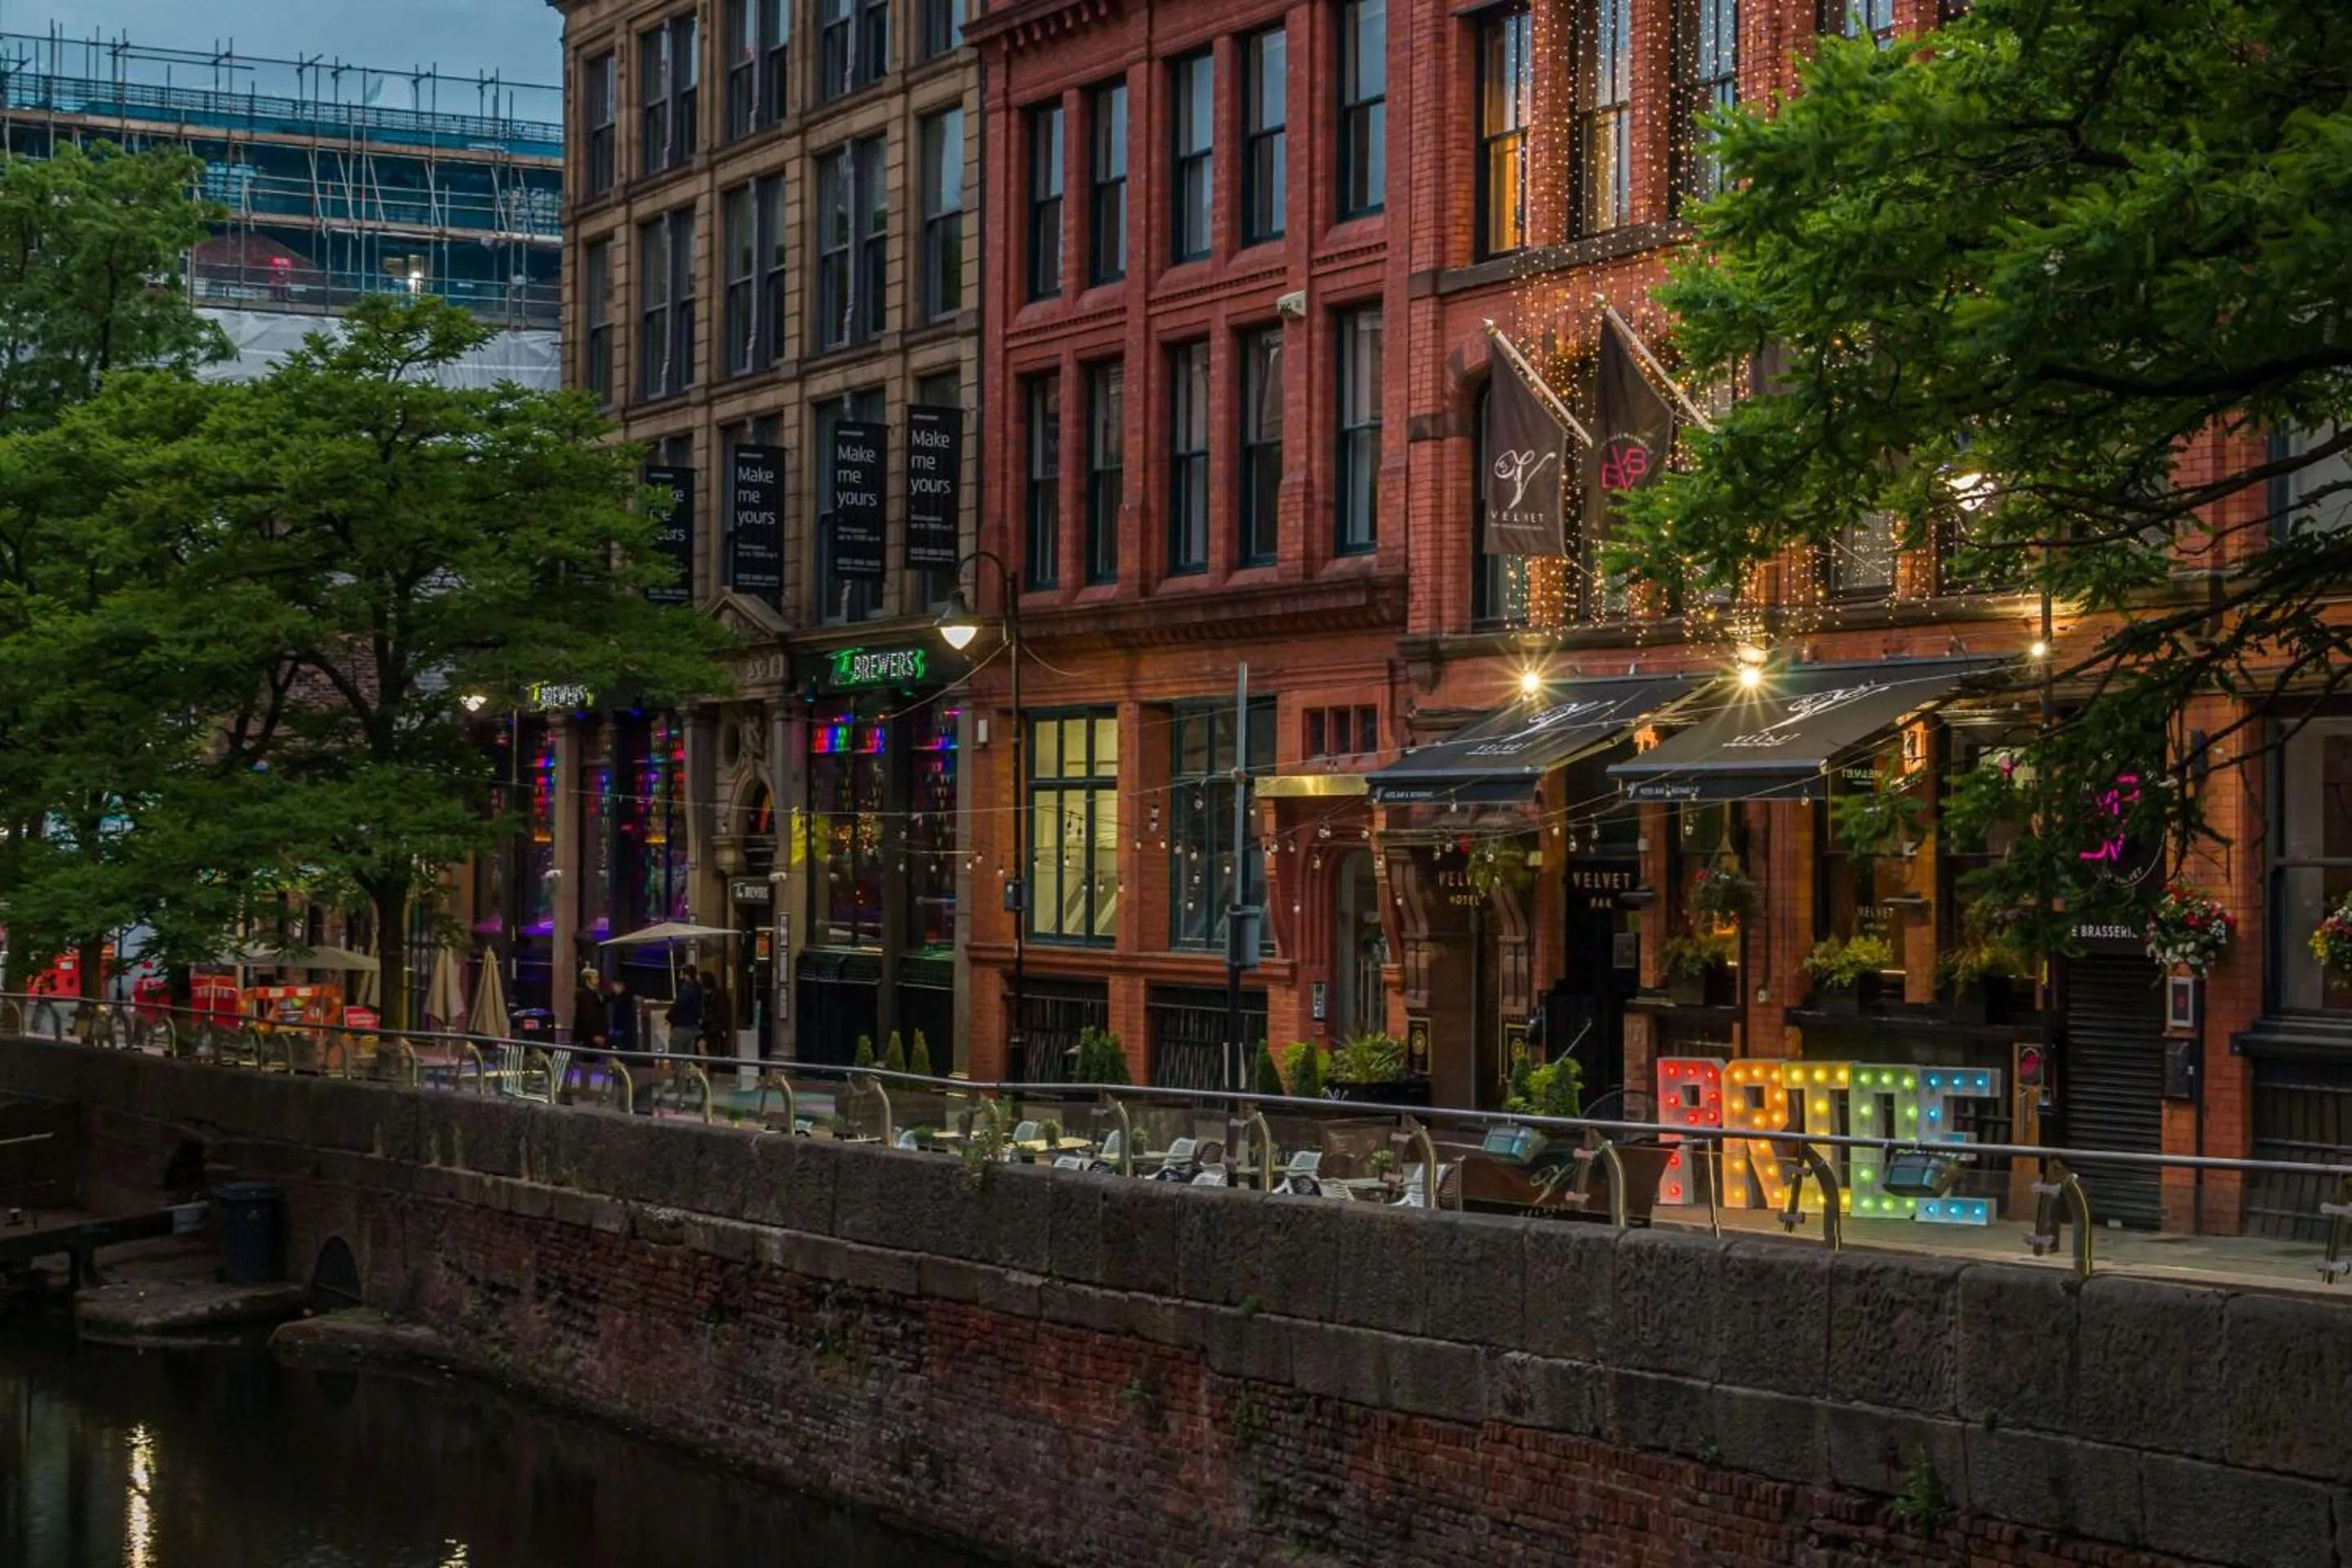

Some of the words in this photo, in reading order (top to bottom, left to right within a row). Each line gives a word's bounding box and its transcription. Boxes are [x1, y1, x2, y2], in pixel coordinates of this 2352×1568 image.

[911, 430, 950, 448] Make
[837, 444, 875, 463] Make
[911, 455, 936, 470] me
[737, 466, 773, 483] Make
[837, 470, 862, 483] me
[911, 478, 951, 497] yours
[737, 489, 760, 504] me
[836, 491, 877, 509] yours
[737, 510, 776, 527] yours
[853, 652, 915, 679] BREWERS
[1573, 871, 1631, 889] VELVET
[1449, 895, 1481, 906] HOTEL
